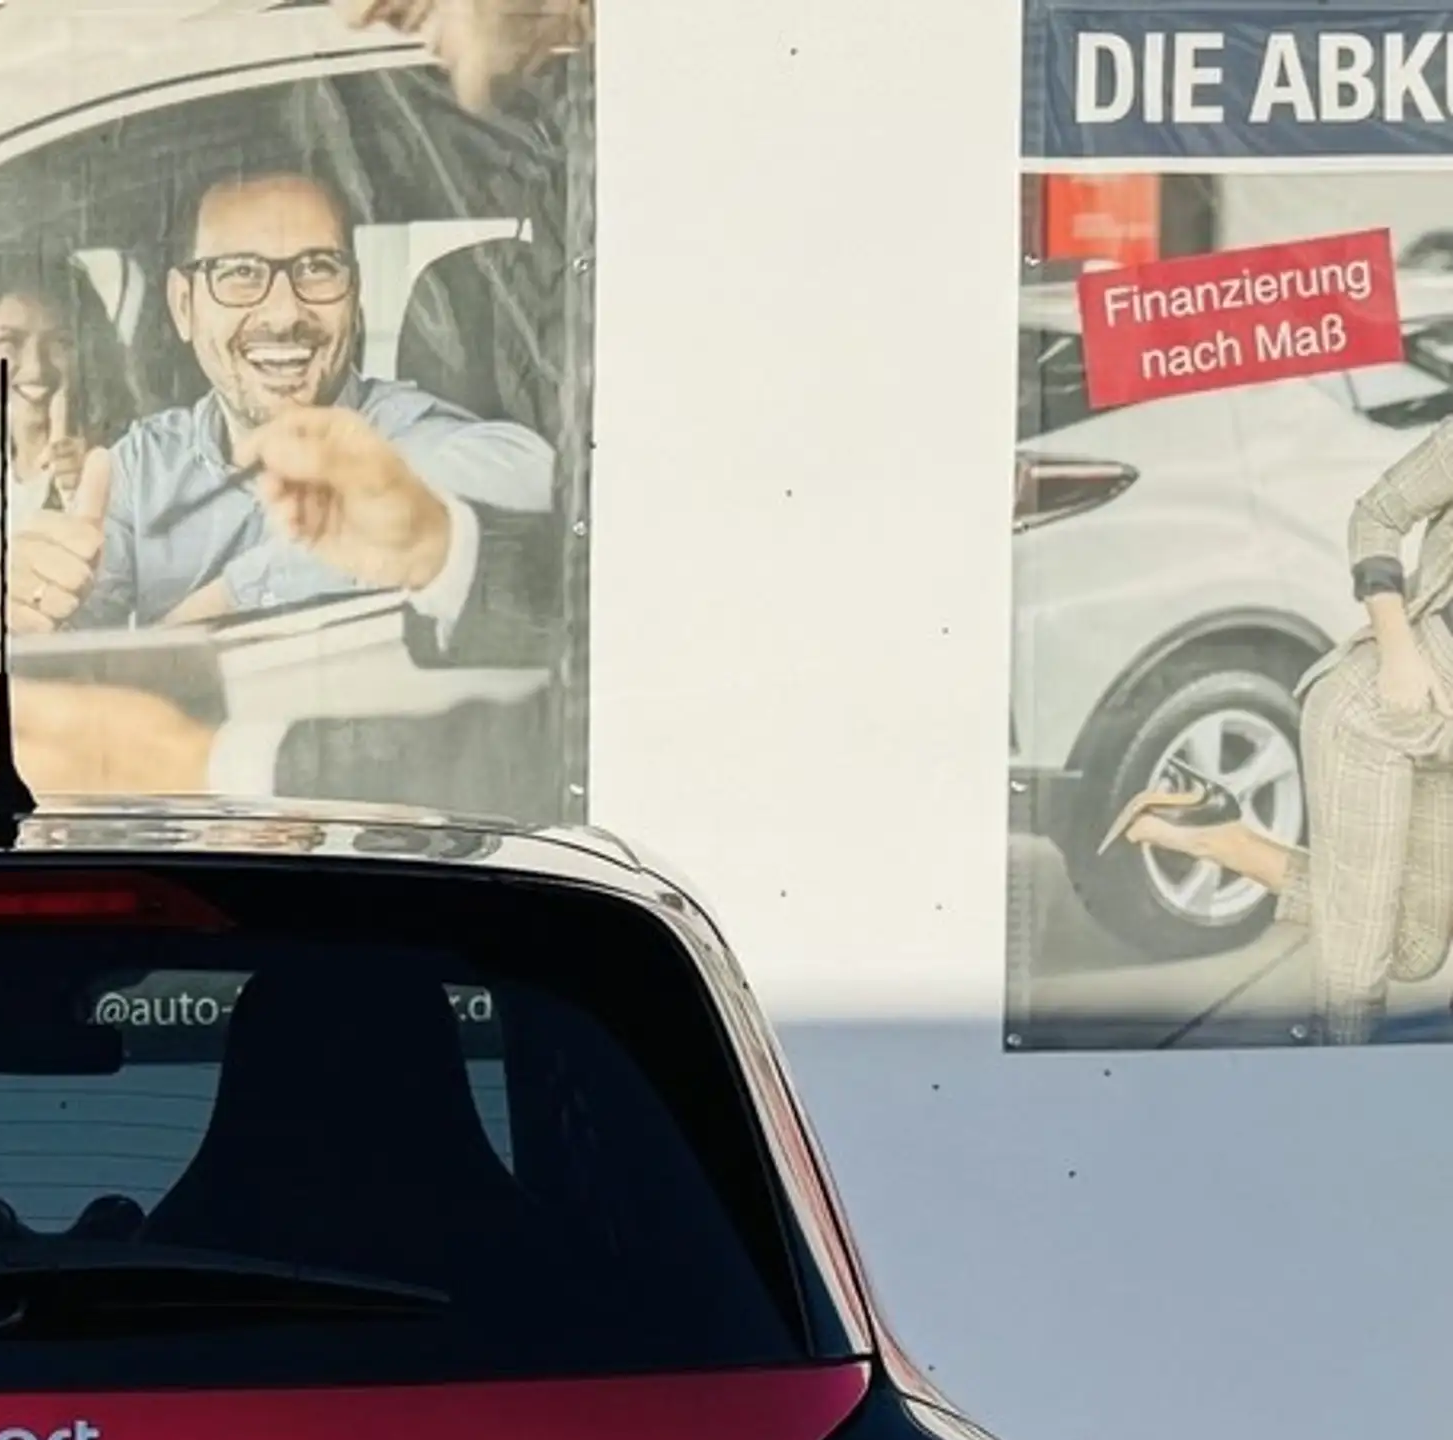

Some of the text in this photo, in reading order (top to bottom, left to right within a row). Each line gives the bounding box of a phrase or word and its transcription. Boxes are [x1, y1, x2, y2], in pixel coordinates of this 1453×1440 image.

[1075, 32, 1453, 123] DIE ABK
[1103, 258, 1373, 328] Finanzierung
[1140, 313, 1348, 379] nach Maß
[96, 986, 243, 1026] @auto-
